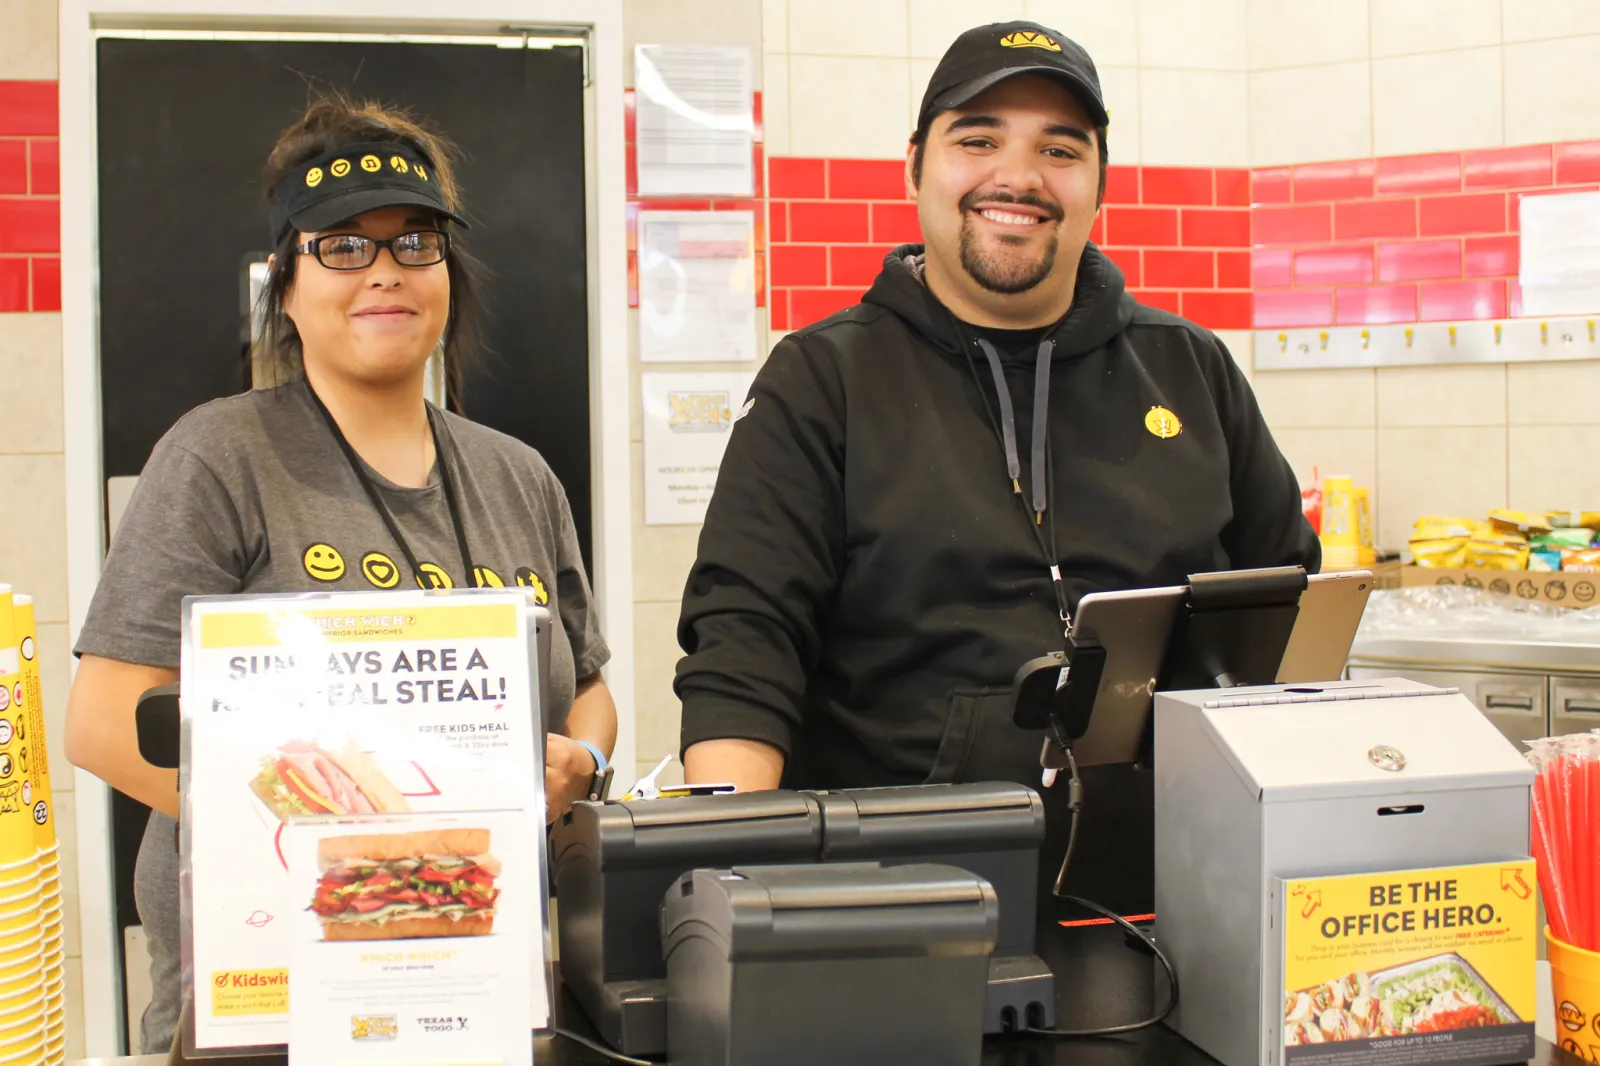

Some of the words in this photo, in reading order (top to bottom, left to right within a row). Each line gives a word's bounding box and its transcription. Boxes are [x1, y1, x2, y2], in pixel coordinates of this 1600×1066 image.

[314, 615, 357, 630] HICH
[354, 628, 403, 637] SANDWICHES
[229, 650, 382, 680] SUNAYS
[391, 648, 457, 673] ARE
[466, 647, 489, 671] A
[317, 681, 388, 707] EAL
[396, 677, 506, 704] STEAL!
[418, 725, 447, 734] FREE
[449, 723, 476, 733] KIDS
[478, 721, 509, 732] MEAL
[36, 807, 47, 821] 22
[1369, 885, 1402, 907] BE
[1407, 879, 1457, 904] THE
[1320, 910, 1415, 939] OFFICE
[1422, 903, 1502, 929] HERO.
[424, 1025, 453, 1033] TOGO
[1393, 1038, 1406, 1047] FOR
[1406, 1037, 1415, 1046] UP
[1415, 1036, 1423, 1045] TO
[1432, 1033, 1453, 1043] PEOPLE
